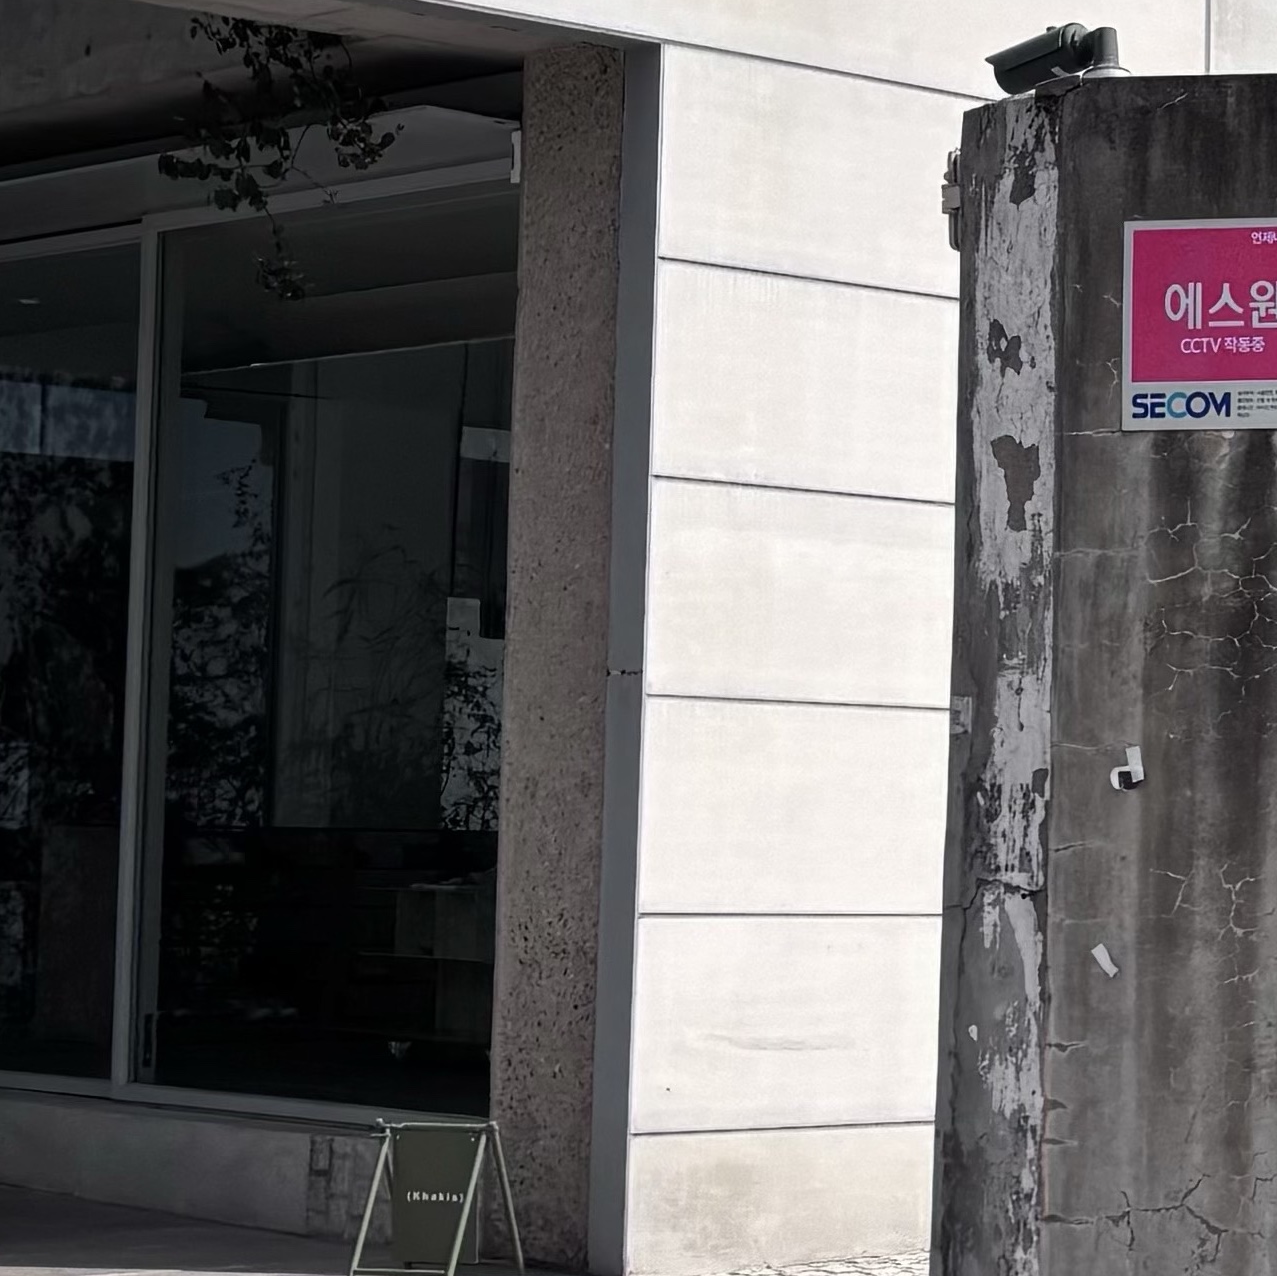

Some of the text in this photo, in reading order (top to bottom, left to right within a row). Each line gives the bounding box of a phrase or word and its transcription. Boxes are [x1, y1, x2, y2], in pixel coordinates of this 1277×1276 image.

[1180, 336, 1265, 354] CCTV 작동중
[1132, 392, 1231, 419] SECOM
